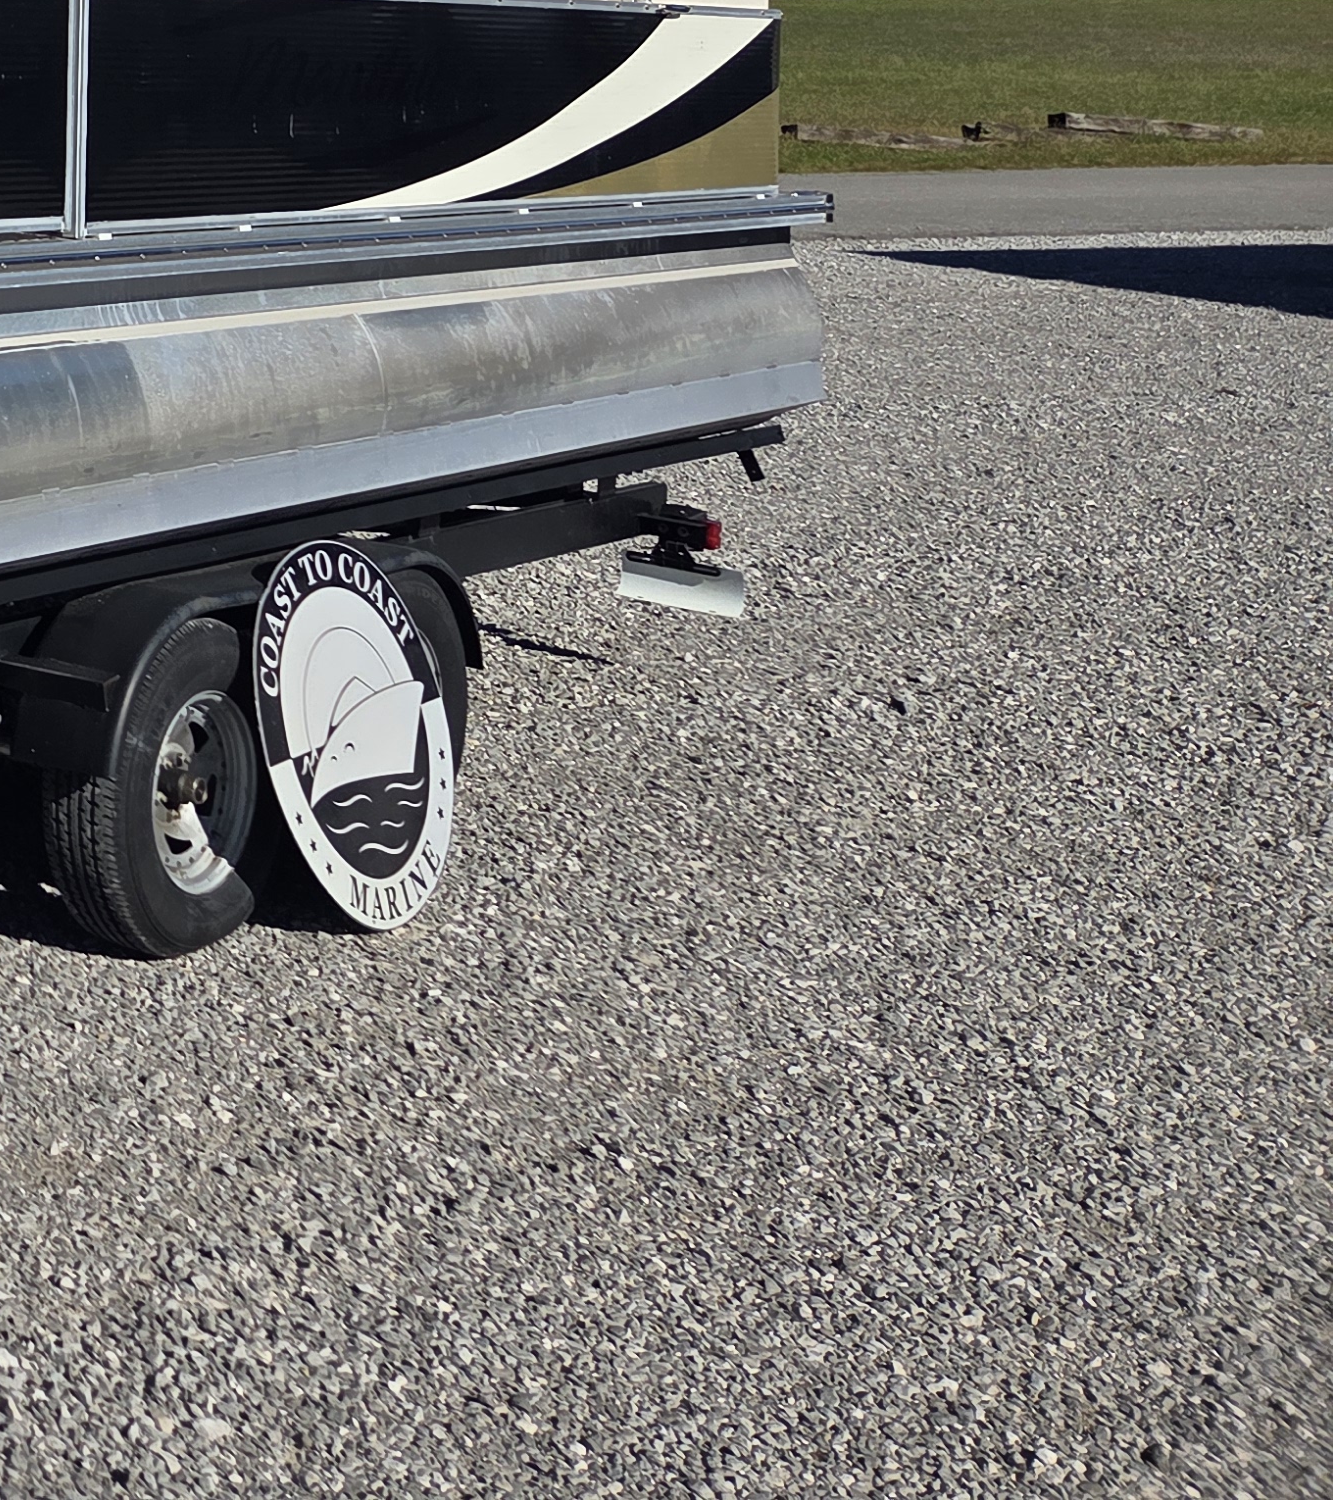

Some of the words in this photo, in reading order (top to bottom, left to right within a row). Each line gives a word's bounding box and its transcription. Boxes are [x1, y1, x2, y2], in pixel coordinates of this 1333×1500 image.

[259, 566, 302, 697] COAST
[298, 549, 333, 585] TO
[338, 553, 414, 647] COAST
[349, 839, 441, 921] MARINE
